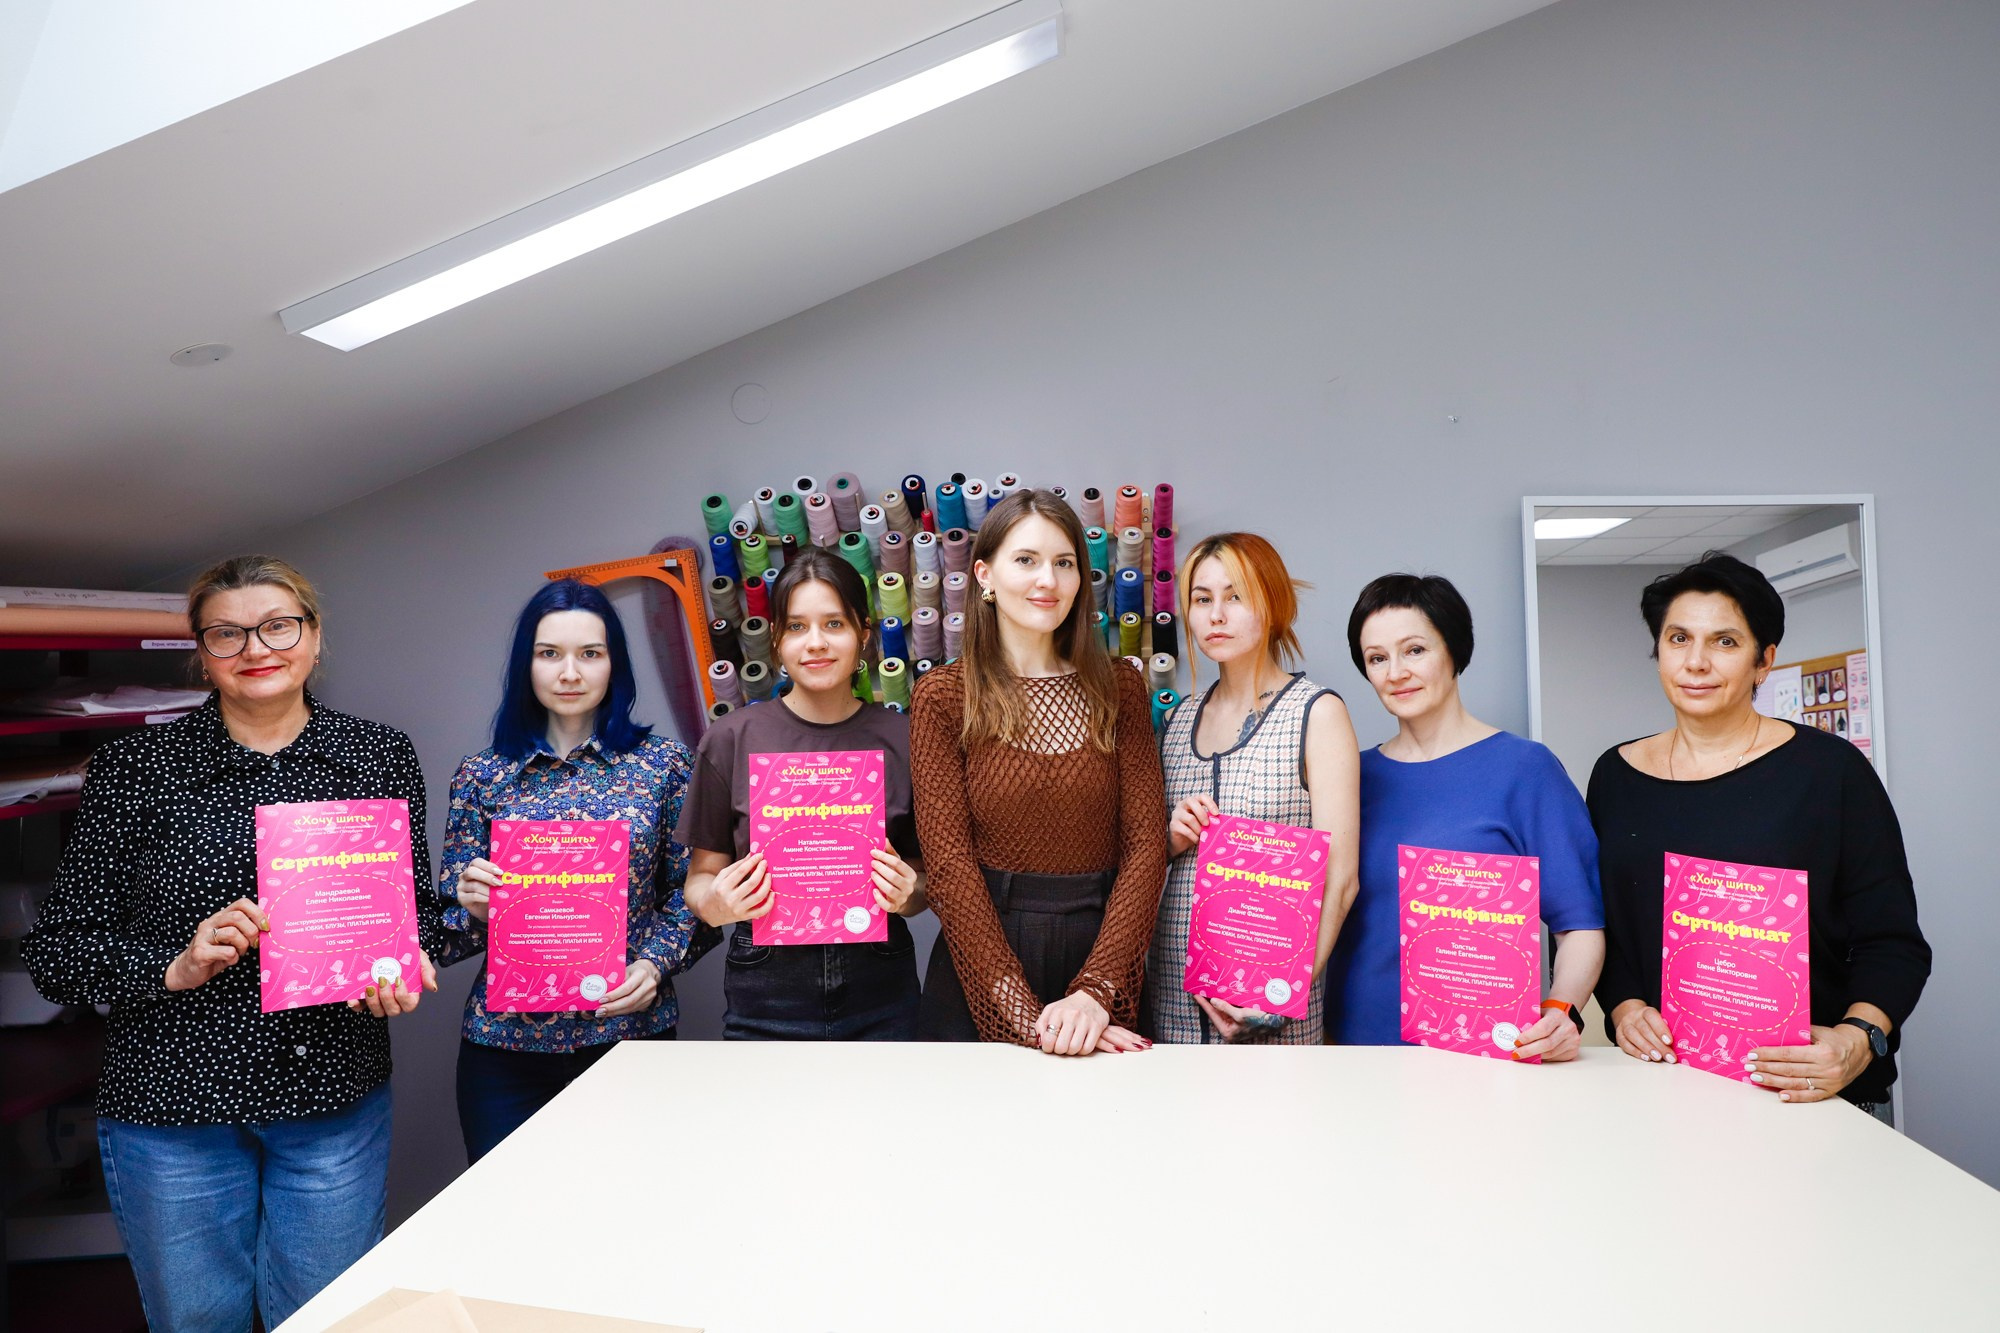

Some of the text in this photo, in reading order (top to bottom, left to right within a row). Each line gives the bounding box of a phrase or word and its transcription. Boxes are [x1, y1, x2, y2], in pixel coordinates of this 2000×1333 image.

[782, 765, 816, 777] «Хочу
[761, 803, 874, 821] Сертификат
[294, 814, 374, 827] «Хочу шить»
[523, 833, 559, 846] «Хочу
[1229, 829, 1263, 845] «Хочу
[1263, 837, 1296, 847] шить»
[271, 851, 399, 873] Сертификат
[1206, 861, 1312, 892] Сертификат
[1427, 863, 1463, 878] «Хочу
[1464, 869, 1501, 879] шить»
[501, 871, 616, 889] Сертификат
[1689, 872, 1725, 889] «Хочу
[1726, 880, 1764, 892] шить»
[328, 894, 371, 902] Николаевне
[339, 912, 385, 920] моделирование
[1227, 906, 1246, 915] Диане
[1409, 899, 1526, 926] Сертификат
[1671, 910, 1792, 944] Сертификат
[1249, 930, 1287, 941] моделирование
[1451, 941, 1477, 951] Толстых
[1435, 946, 1495, 960] Галине Евгеньевне
[1714, 957, 1735, 968] Цебро
[1464, 972, 1507, 981] моделирование
[1696, 961, 1757, 980] Елене Викторовне
[1471, 978, 1492, 986] ПЛАТЬЯ
[1725, 990, 1770, 1003] моделирование
[1732, 997, 1754, 1007] ПЛАТЬЯ
[1760, 1003, 1778, 1011] БРЮК
